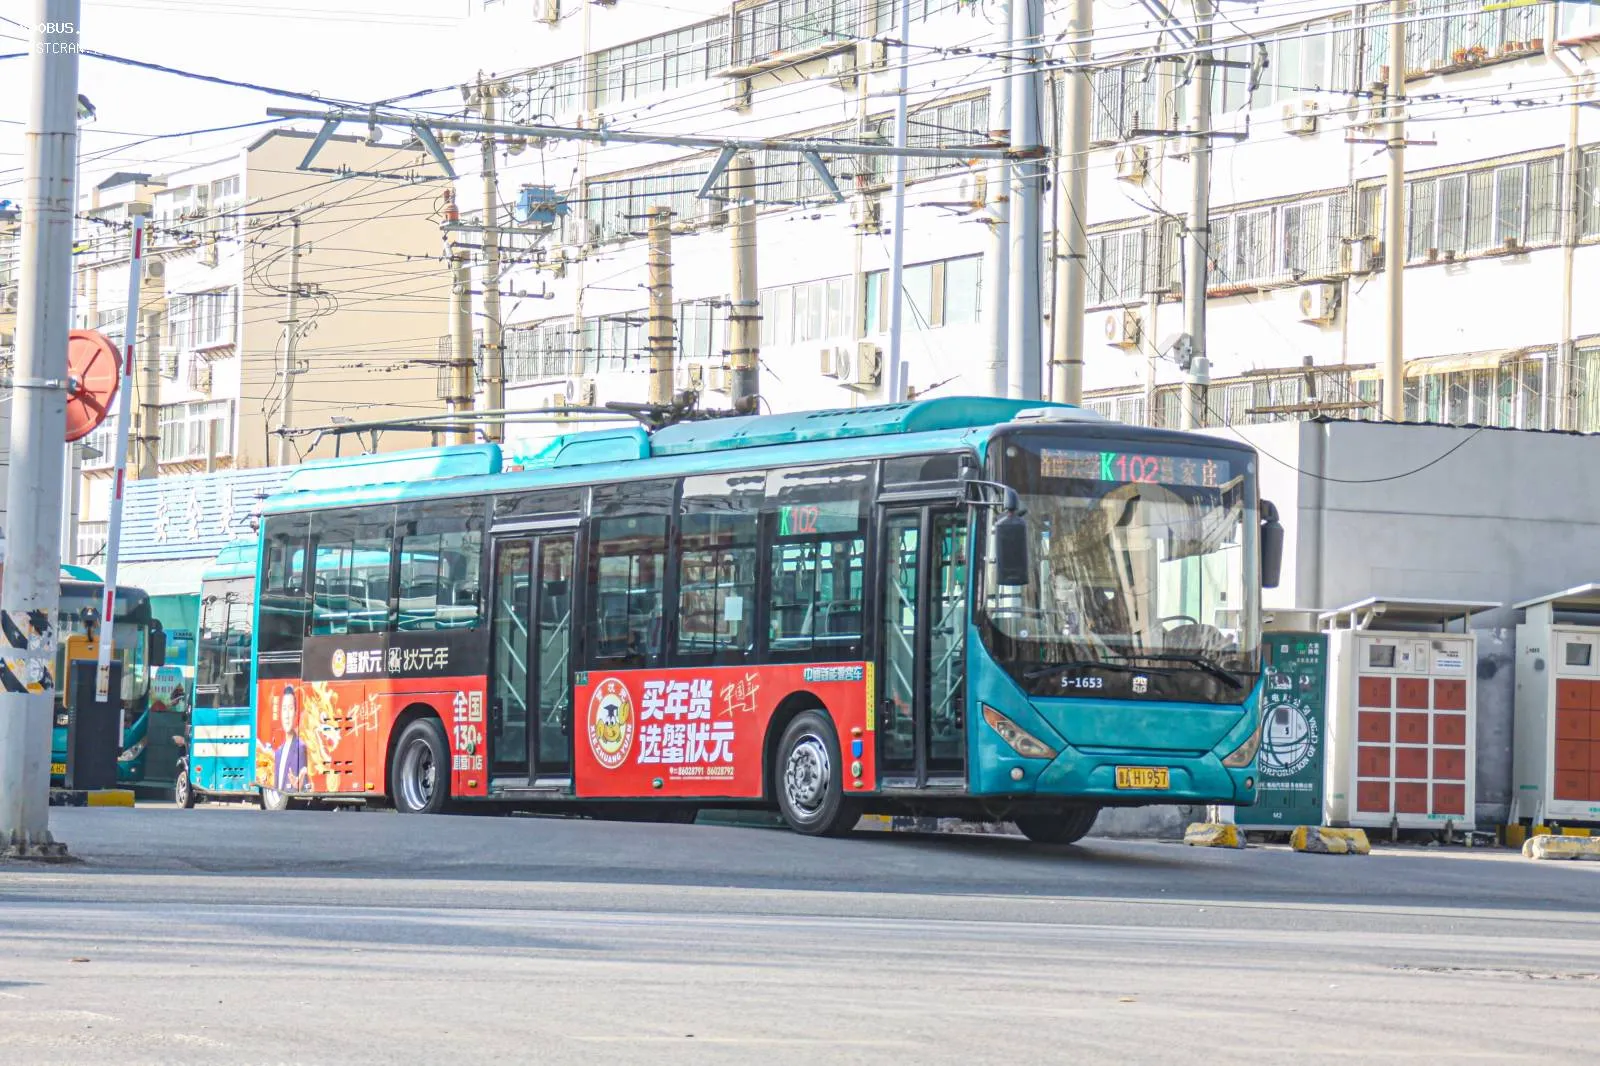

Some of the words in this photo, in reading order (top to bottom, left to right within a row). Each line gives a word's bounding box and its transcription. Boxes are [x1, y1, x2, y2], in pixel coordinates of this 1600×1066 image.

[1100, 452, 1159, 484] K102
[779, 505, 817, 535] K102
[1061, 676, 1103, 689] 5-1653
[452, 691, 483, 722] 全国
[640, 679, 713, 720] 买年货
[637, 721, 735, 764] 选蟹状元
